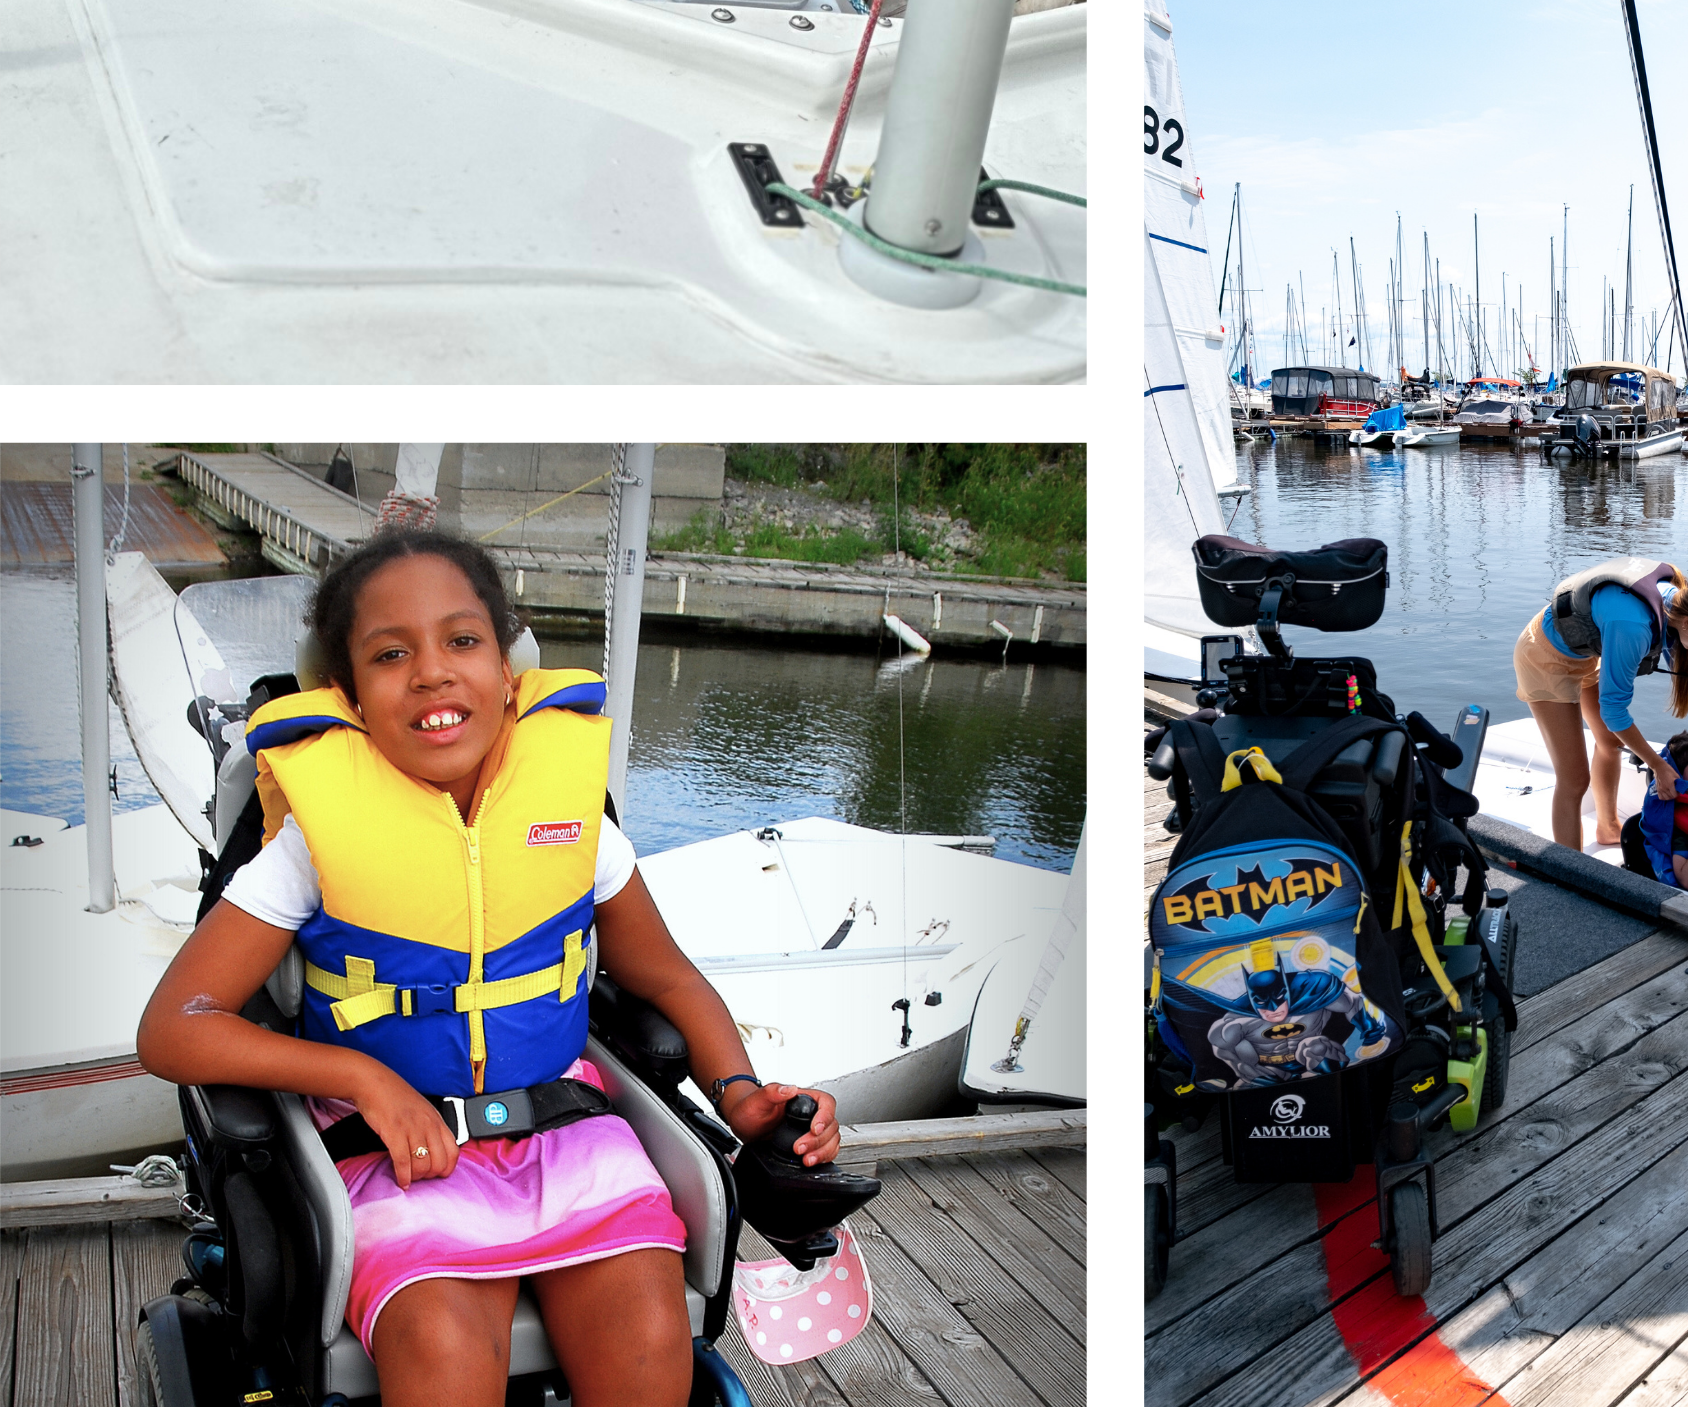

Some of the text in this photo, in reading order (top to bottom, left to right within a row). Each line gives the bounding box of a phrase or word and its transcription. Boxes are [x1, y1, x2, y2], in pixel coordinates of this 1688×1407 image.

[531, 825, 571, 840] Coleman
[1163, 862, 1343, 925] BATMAN
[1249, 1125, 1331, 1137] AMYLIOR
